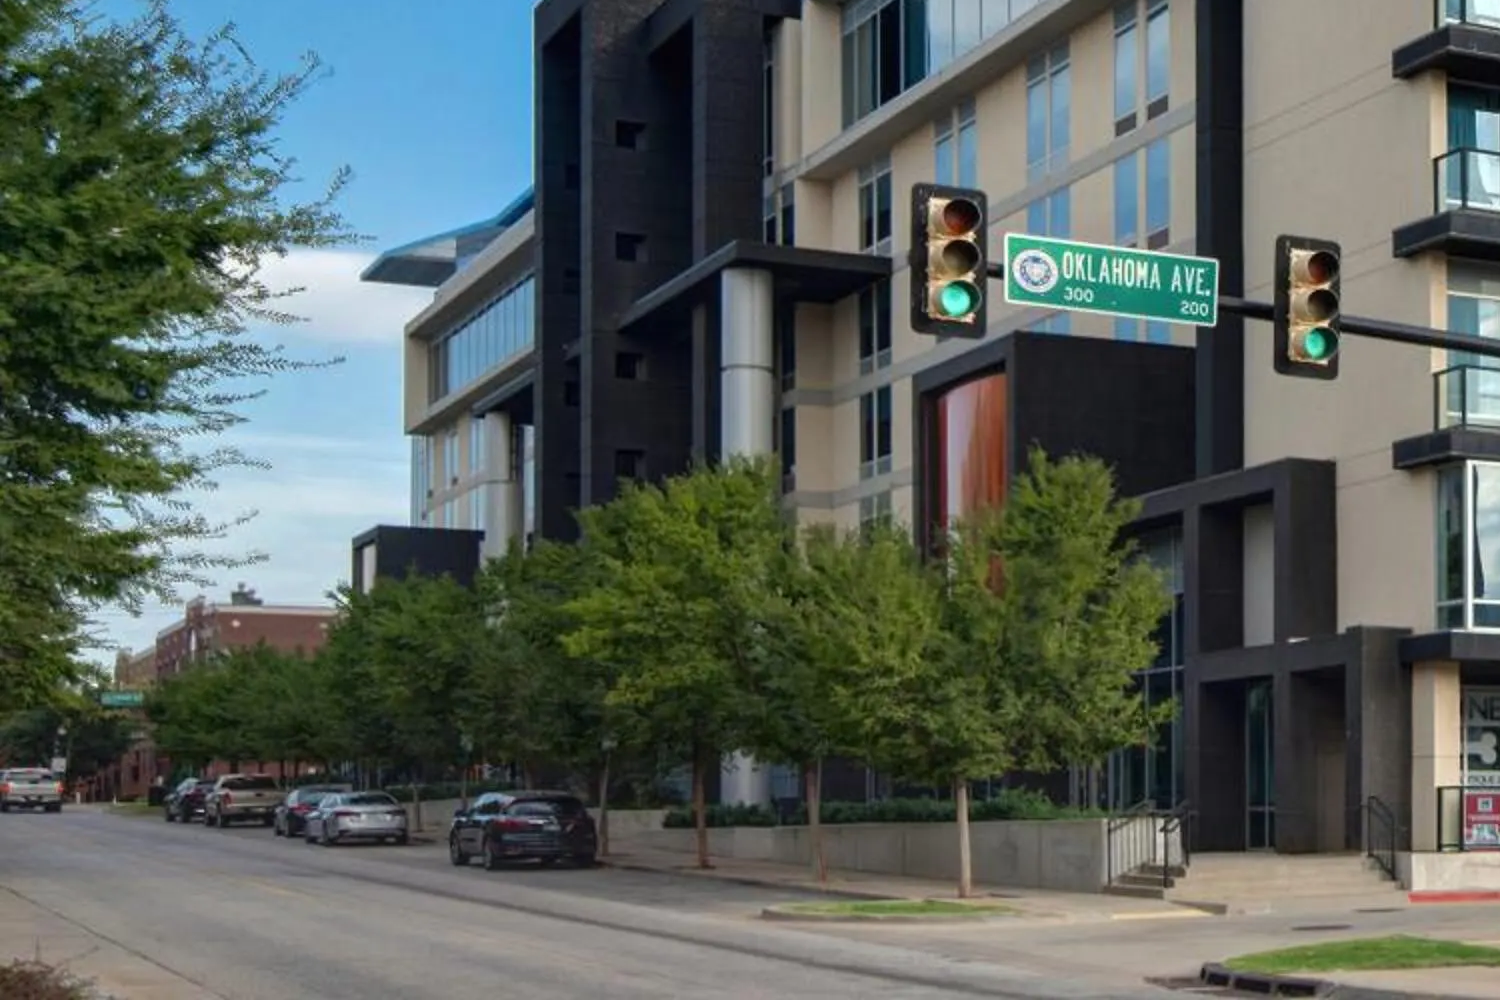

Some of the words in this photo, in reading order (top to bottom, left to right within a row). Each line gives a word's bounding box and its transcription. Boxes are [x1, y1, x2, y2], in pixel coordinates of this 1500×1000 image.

[1062, 251, 1161, 291] OKLAHOMA
[1171, 265, 1211, 297] AVE.
[1064, 287, 1094, 303] 300
[1180, 300, 1209, 316] 200
